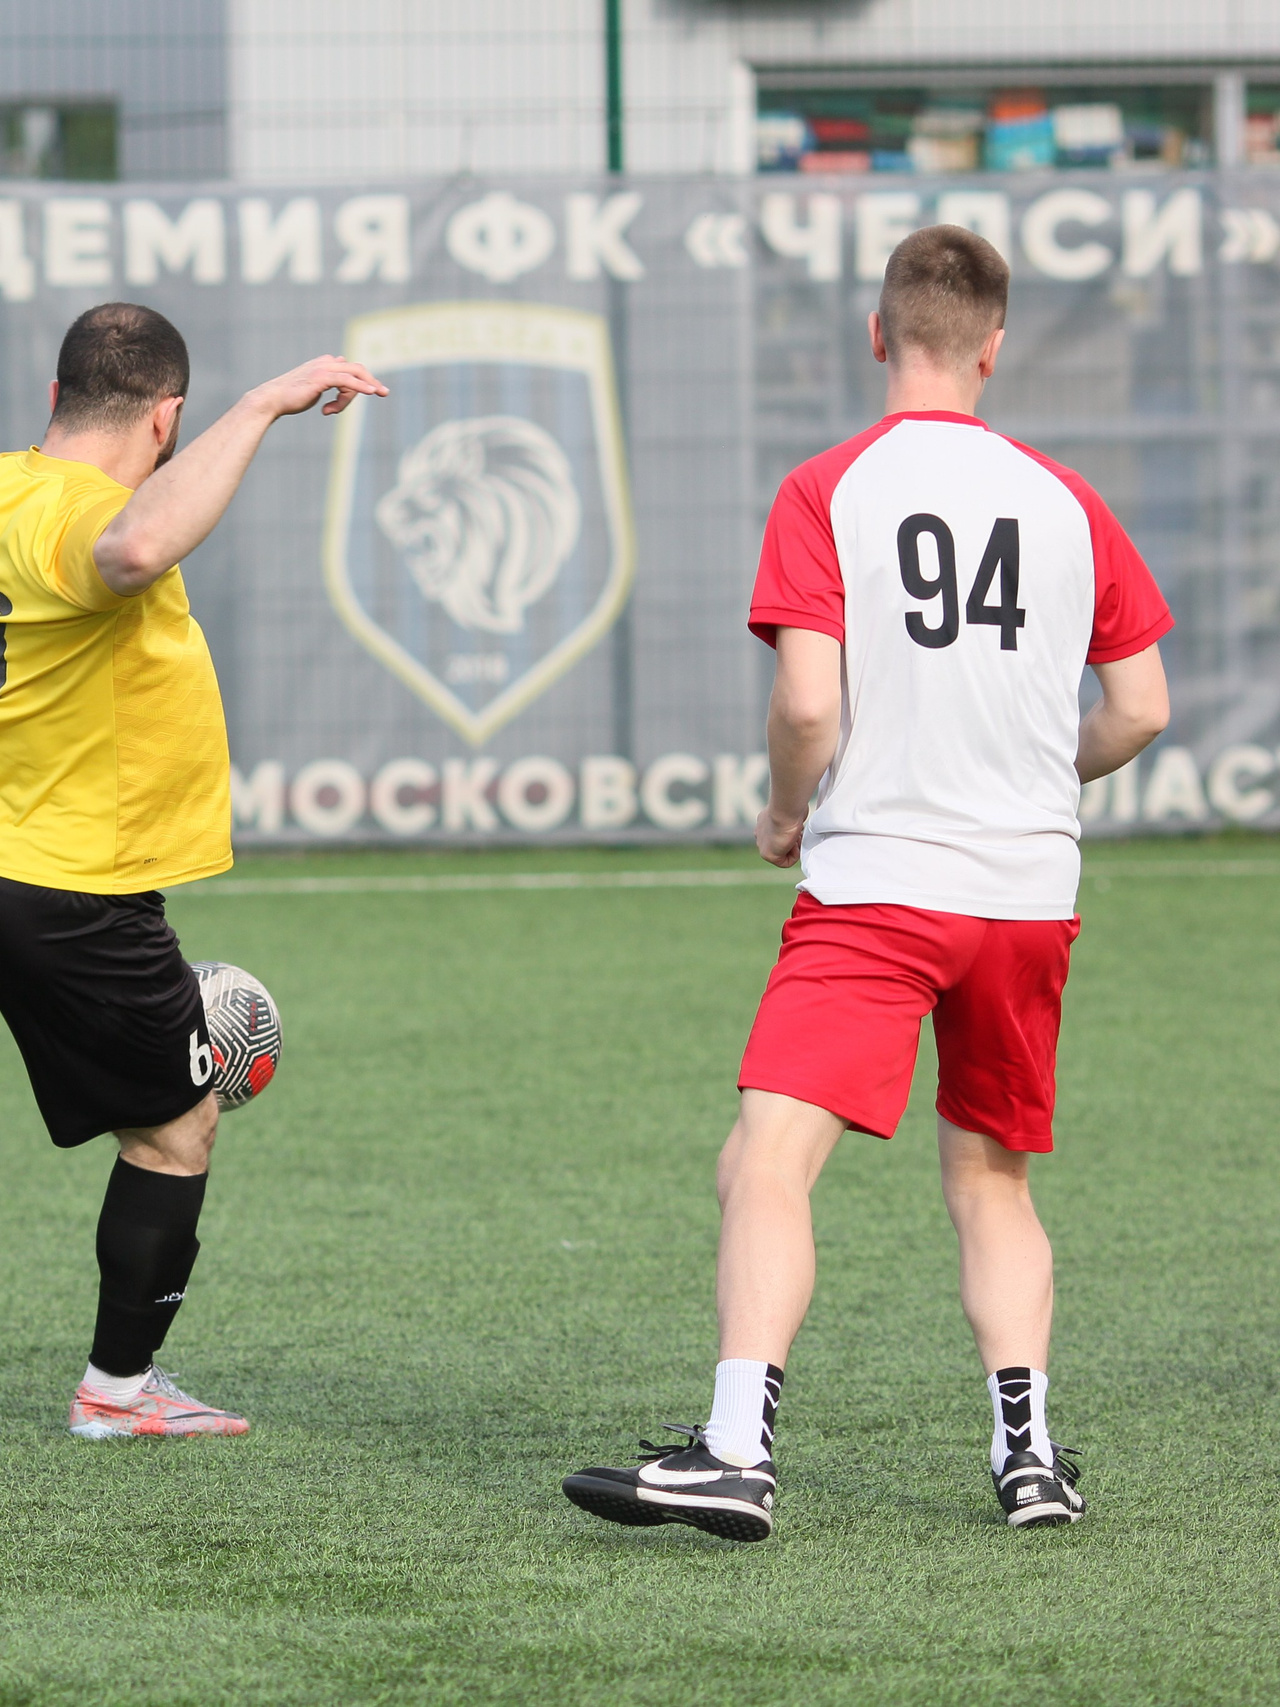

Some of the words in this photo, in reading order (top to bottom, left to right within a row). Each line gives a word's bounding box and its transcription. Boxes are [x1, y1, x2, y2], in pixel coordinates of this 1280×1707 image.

[445, 191, 645, 282] ФК
[896, 512, 1027, 651] 94
[230, 752, 771, 836] МОСКОВСК
[1017, 1483, 1039, 1501] NIKE
